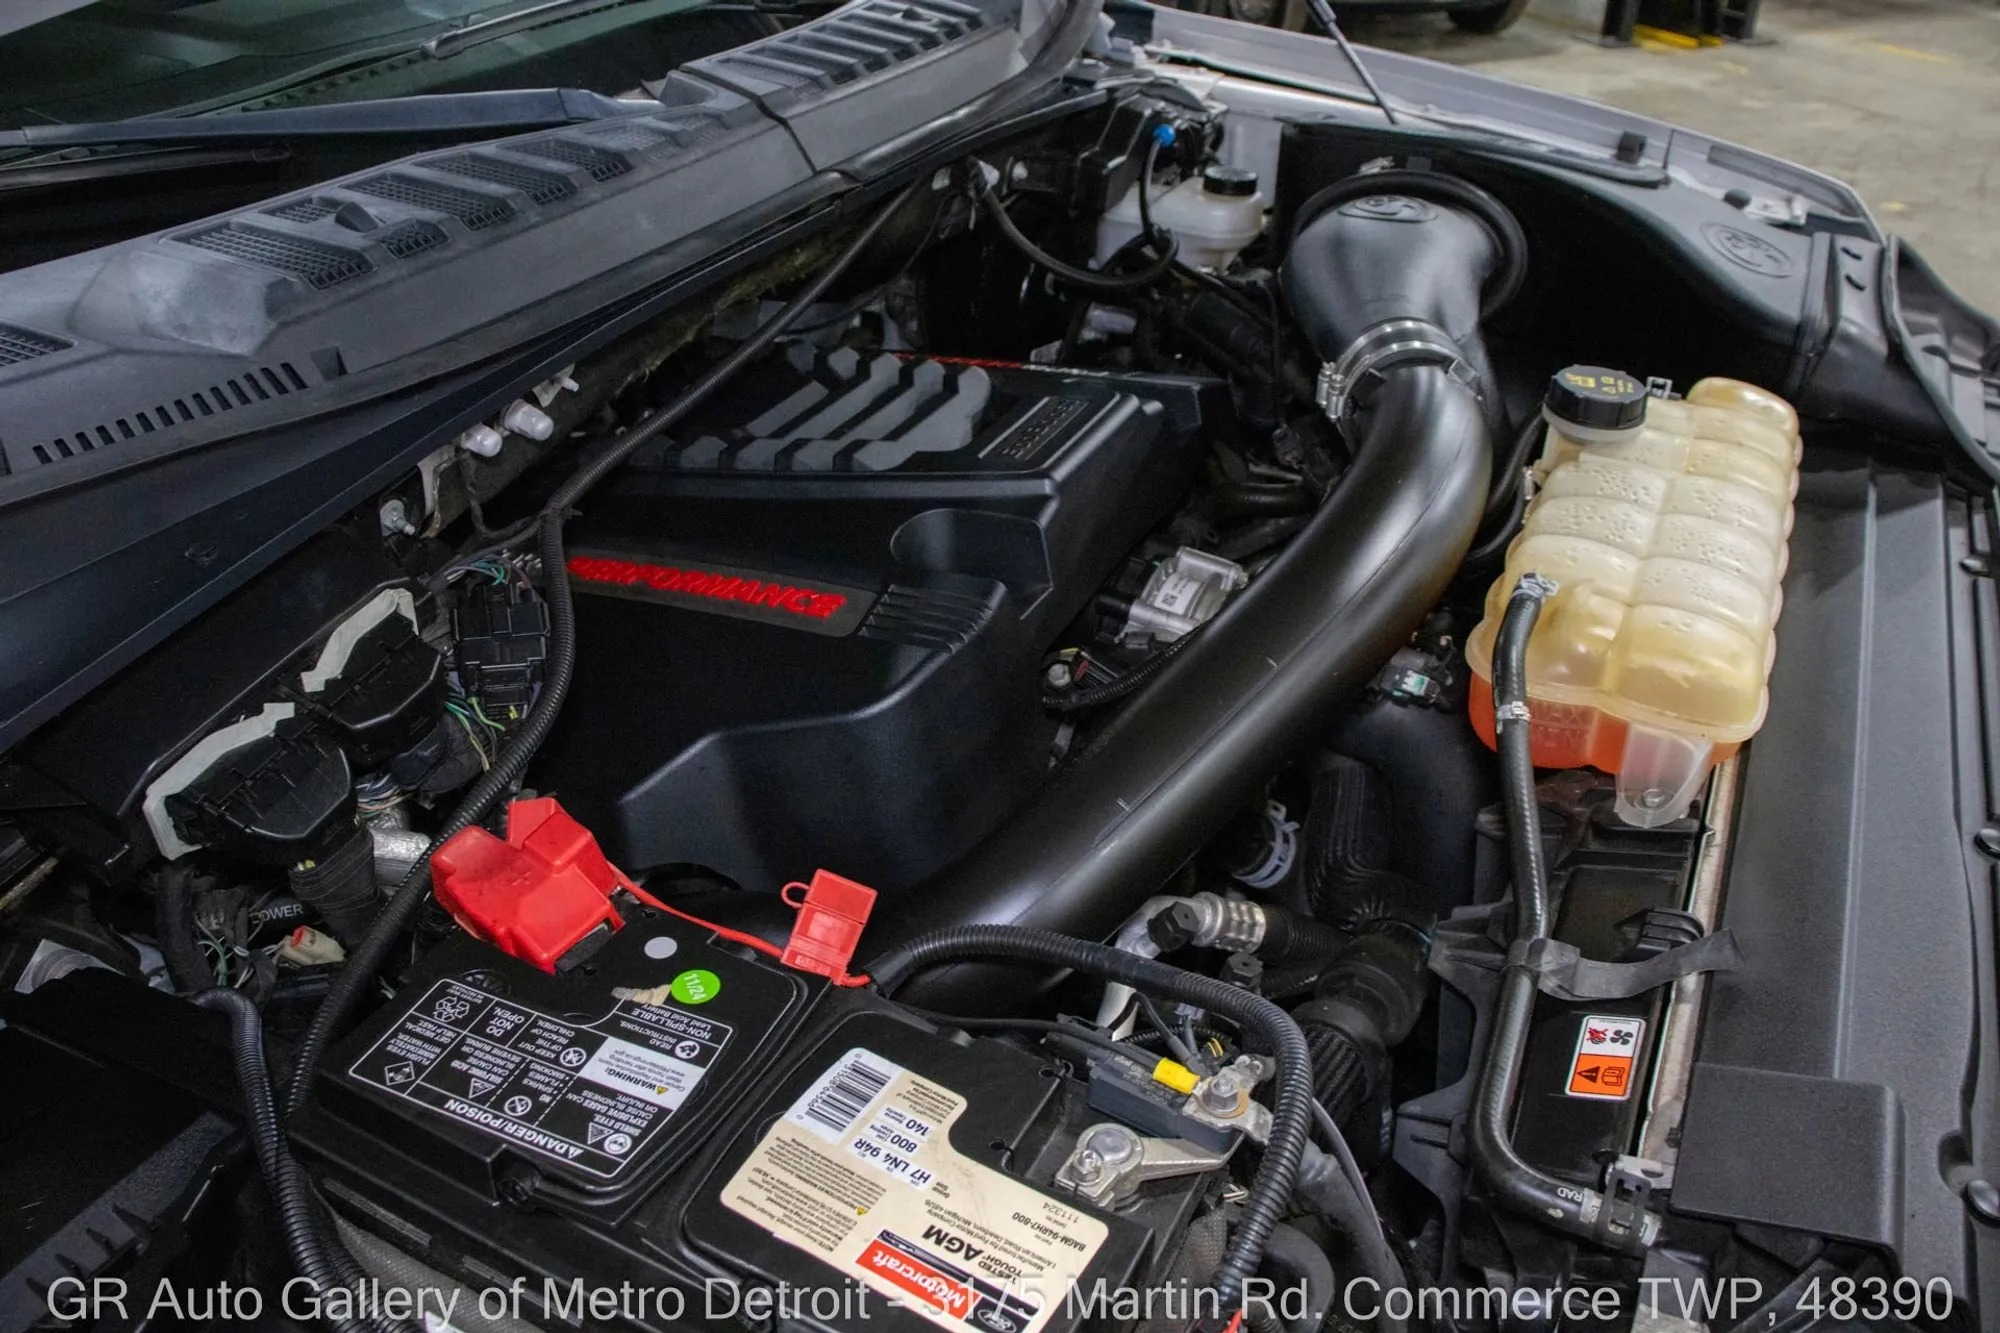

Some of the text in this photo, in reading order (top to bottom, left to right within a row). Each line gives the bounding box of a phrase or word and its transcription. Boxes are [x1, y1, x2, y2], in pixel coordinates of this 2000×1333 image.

[488, 1016, 515, 1029] NOT
[489, 1006, 526, 1023] OPEN.
[629, 1007, 712, 1039] NON-SPILLABLE
[639, 1003, 712, 1030] Lead Acid Battery
[401, 1021, 452, 1043] GET MEDICAL
[435, 1027, 457, 1037] HELP
[484, 1024, 505, 1036] DO
[529, 1026, 569, 1043] REACH OF
[533, 1019, 576, 1036] CHILDREN.
[616, 1019, 678, 1043] INSTRUCTIONS.
[420, 1042, 442, 1053] WITH
[517, 1040, 557, 1058] KEEP OUT
[534, 1037, 563, 1050] OF THE
[647, 1037, 673, 1049] READ
[385, 1044, 432, 1065] FLUSH EYES
[459, 1044, 517, 1069] BLINDNESS OR
[490, 1047, 522, 1062] SEVERE
[448, 1059, 504, 1084] SULFURIC ACID
[465, 1056, 510, 1076] CAN CAUSE
[528, 1061, 567, 1079] SMOKING
[828, 1063, 852, 1086] 31508
[520, 1077, 554, 1093] SPARKS
[526, 1070, 561, 1086] FLAMES
[602, 1066, 658, 1090] WARNING:
[537, 1093, 553, 1103] NO
[580, 1089, 654, 1120] CAUSE BLINDNESS
[613, 1093, 659, 1113] OR INJURY.
[806, 1085, 831, 1109] 64566
[564, 1092, 648, 1128] EXPLOSIVE GASES CAN
[442, 1098, 571, 1154] DANGER/POISON
[589, 1112, 642, 1136] SHIELD EYES.
[903, 1118, 931, 1136] 140
[888, 1133, 918, 1153] 800
[852, 1137, 931, 1183] H7 LN4 94R
[1556, 1187, 1583, 1203] RAD
[942, 1207, 973, 1226] Michigan
[1041, 1201, 1080, 1224] 111324
[924, 1207, 1045, 1271] Manufactured for Ford Motor Company
[1010, 1210, 1086, 1252] BAGM-94RH7-800
[919, 1223, 984, 1263] AGM
[1020, 1247, 1053, 1266] American
[866, 1248, 970, 1309] Motorcraft
